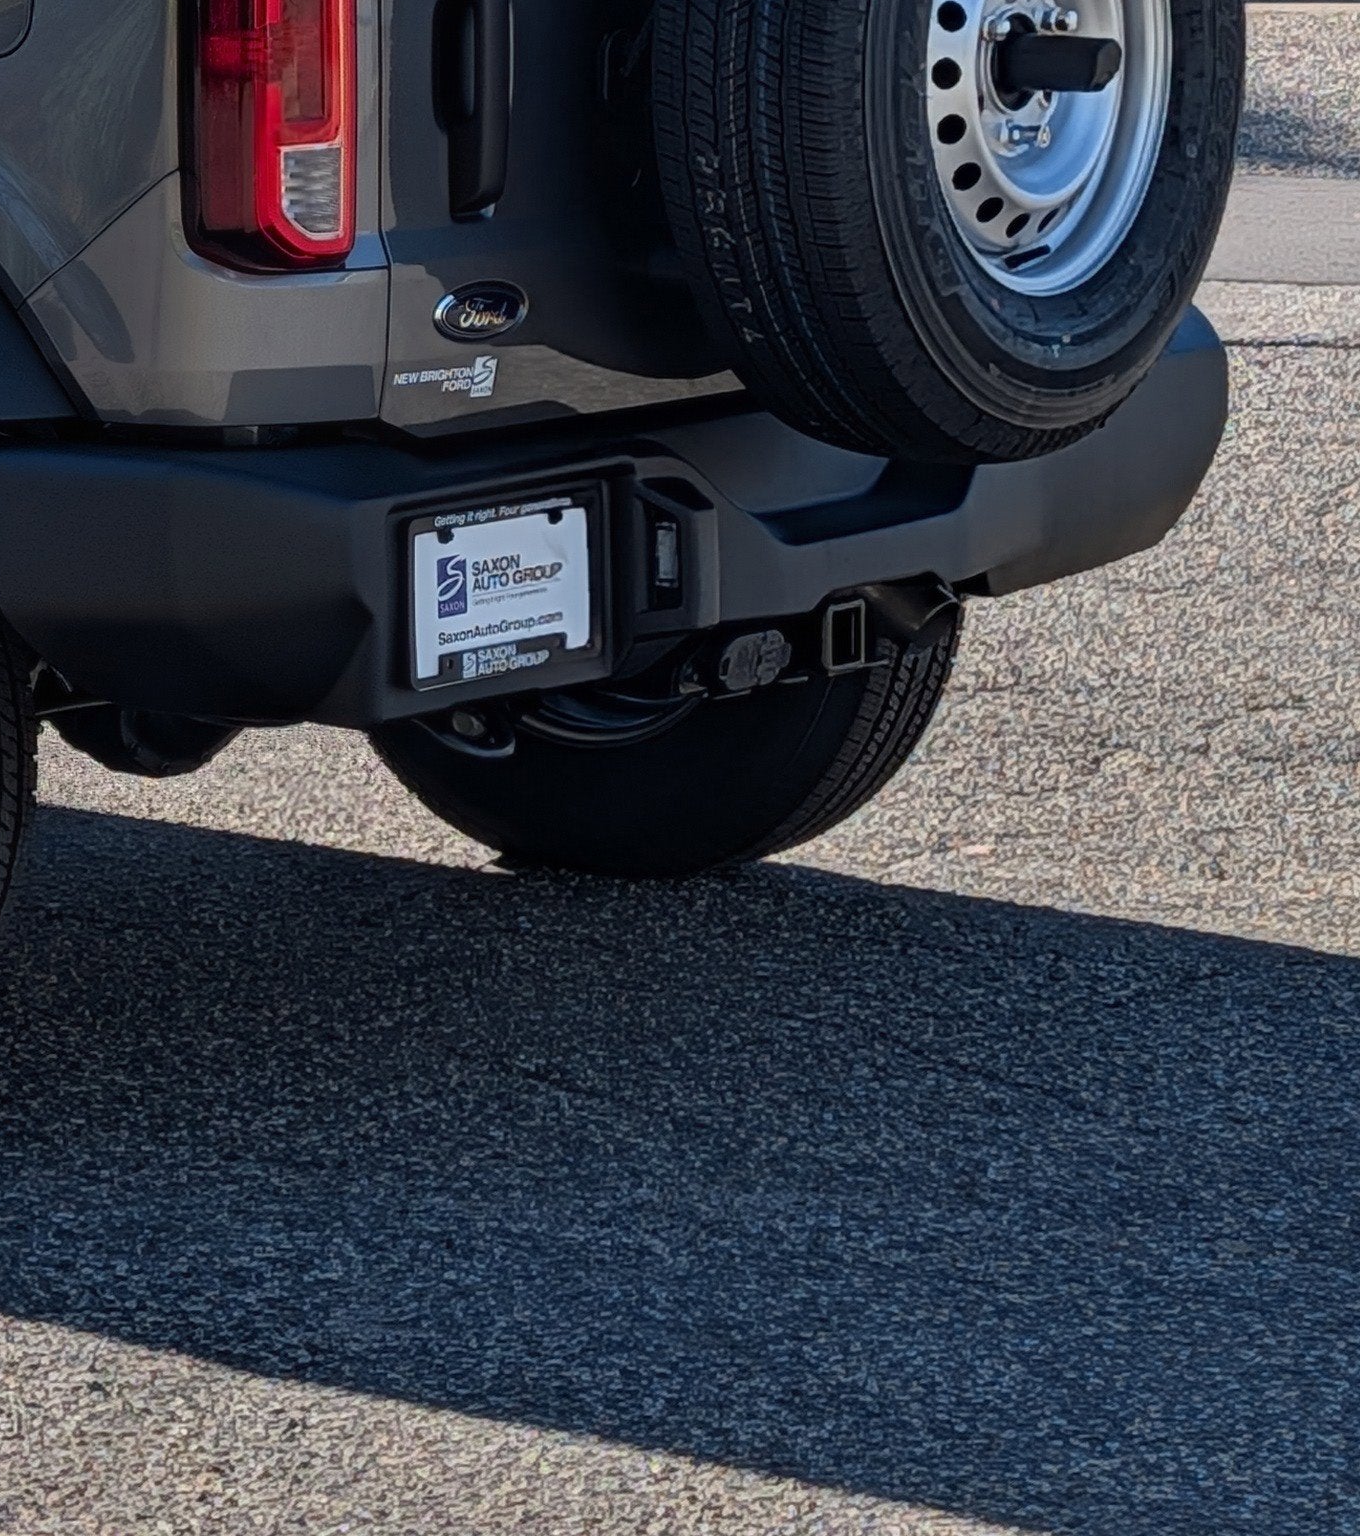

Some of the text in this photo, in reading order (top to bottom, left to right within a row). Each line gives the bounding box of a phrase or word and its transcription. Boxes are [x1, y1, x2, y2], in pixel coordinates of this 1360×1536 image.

[458, 297, 508, 328] Ford
[393, 366, 475, 385] NEW BRIGHTON
[441, 378, 473, 392] FORD
[434, 514, 466, 528] Getting
[466, 511, 475, 522] it
[499, 505, 520, 517] Four
[471, 554, 521, 576] SAXON
[472, 561, 563, 593] AUTO GROUP
[439, 601, 465, 614] SAXON
[438, 611, 563, 645] SaxonAutoGroup.com
[477, 644, 517, 662] SAXON
[477, 659, 509, 677] AUTO
[508, 649, 550, 670] GROUP
